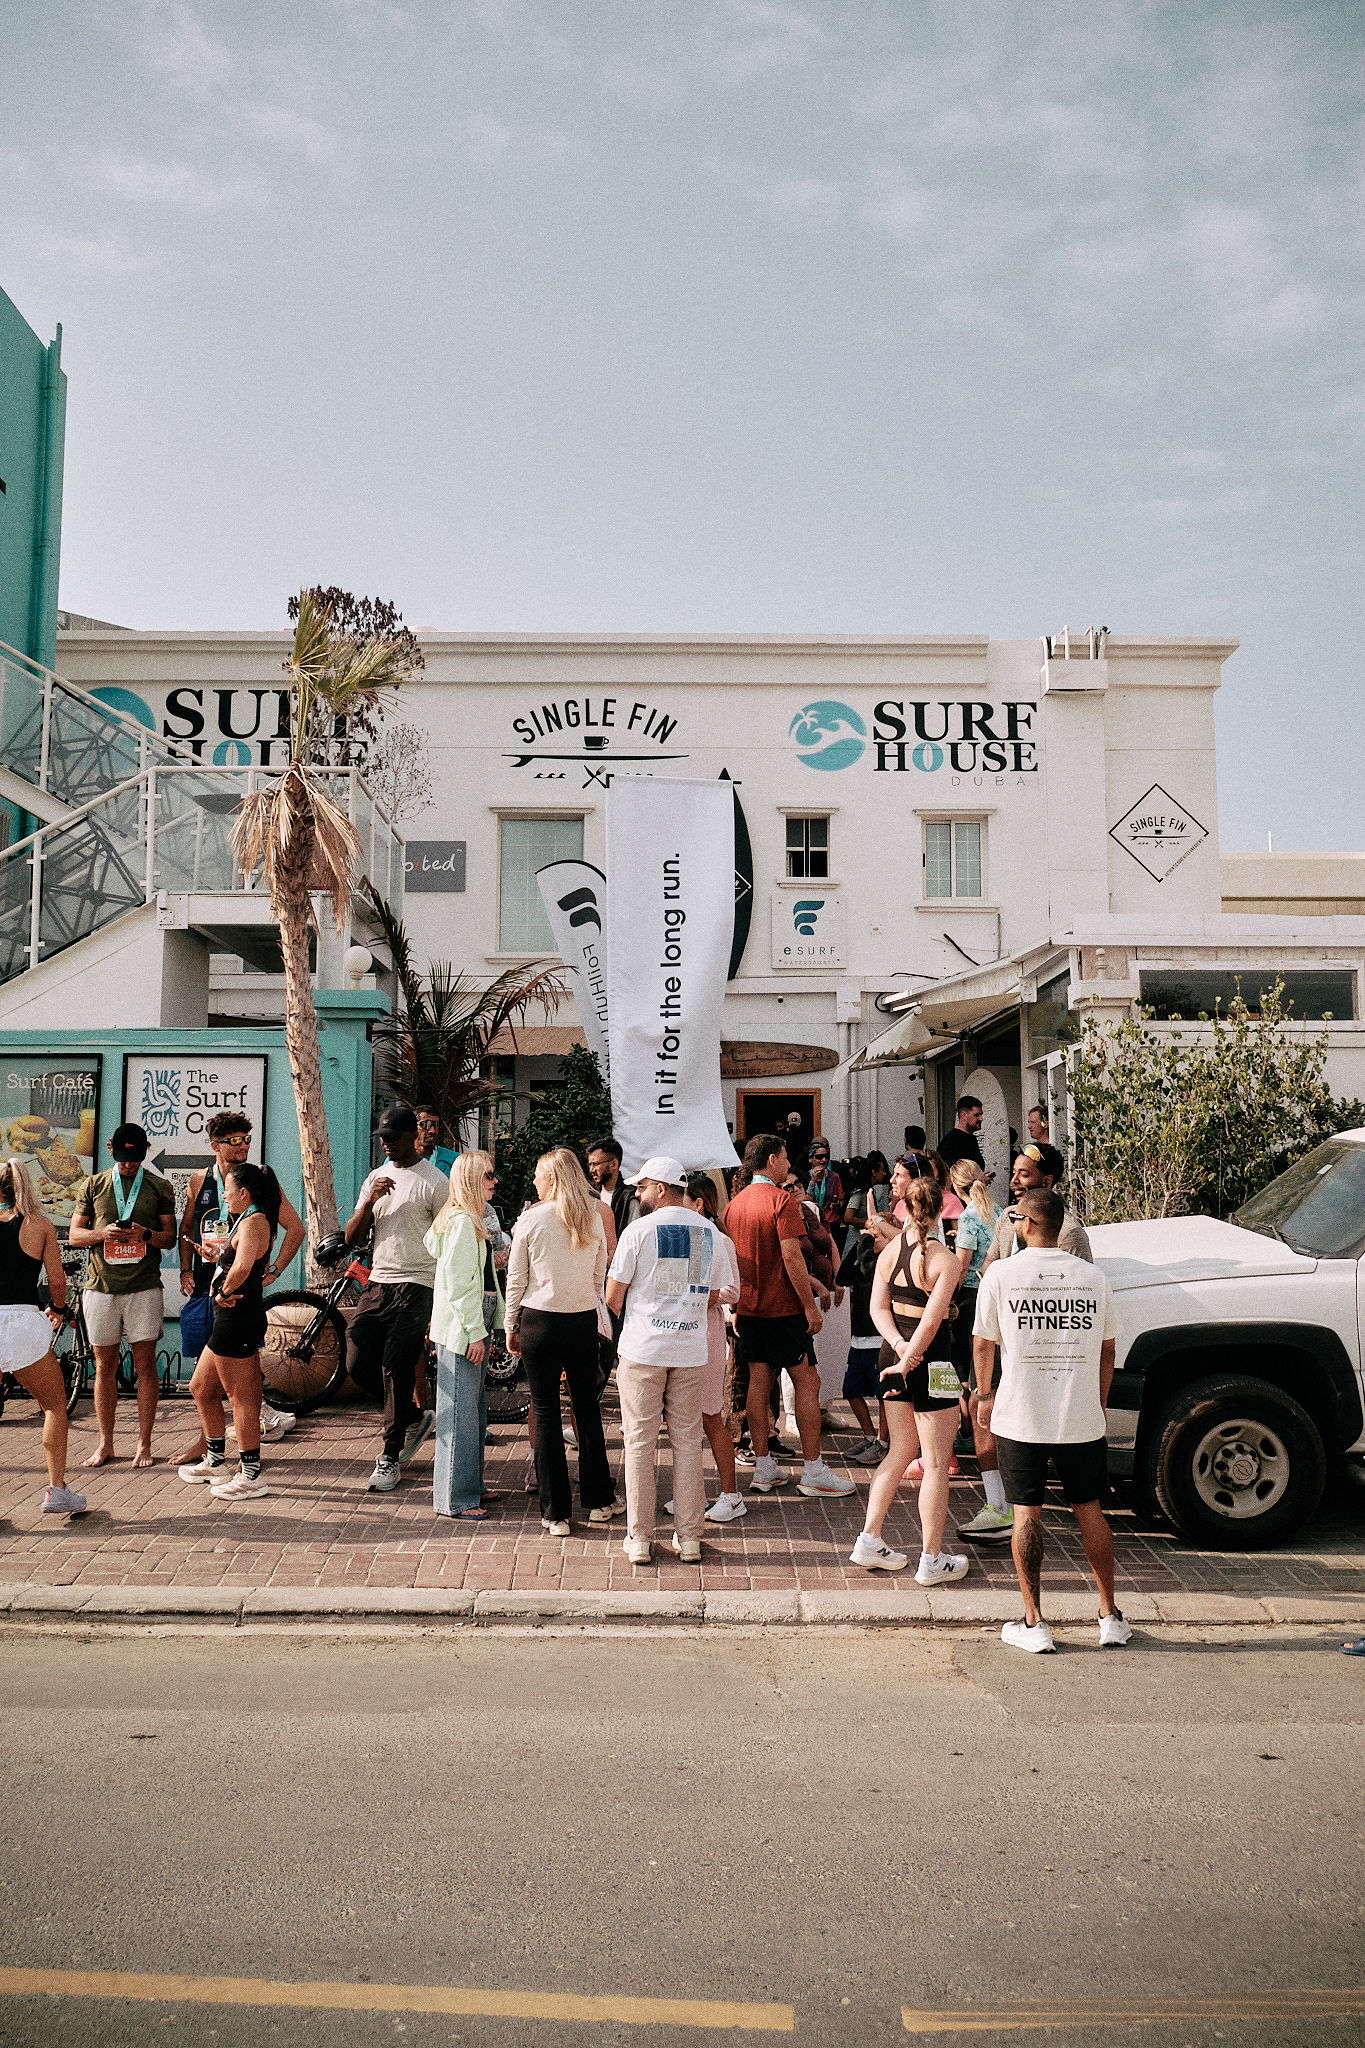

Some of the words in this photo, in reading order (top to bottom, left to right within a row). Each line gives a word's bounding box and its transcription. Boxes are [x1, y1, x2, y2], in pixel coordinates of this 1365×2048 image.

[512, 698, 617, 744] SINGLE
[627, 702, 679, 745] FIN
[873, 700, 1038, 742] SURF
[873, 741, 1039, 773] HOUSE
[1129, 816, 1166, 833] SINGLE
[1168, 817, 1187, 833] FIN
[662, 853, 681, 900] run.
[660, 908, 686, 967] long
[659, 976, 682, 1019] the
[657, 1025, 681, 1061] for
[7, 1073, 48, 1089] Surf
[53, 1073, 94, 1089] Café
[186, 1069, 219, 1083] The
[654, 1069, 677, 1084] it
[185, 1084, 248, 1109] Surf
[655, 1093, 676, 1115] In
[1008, 1299, 1097, 1314] VANQUISH
[1018, 1315, 1093, 1330] FITNESS
